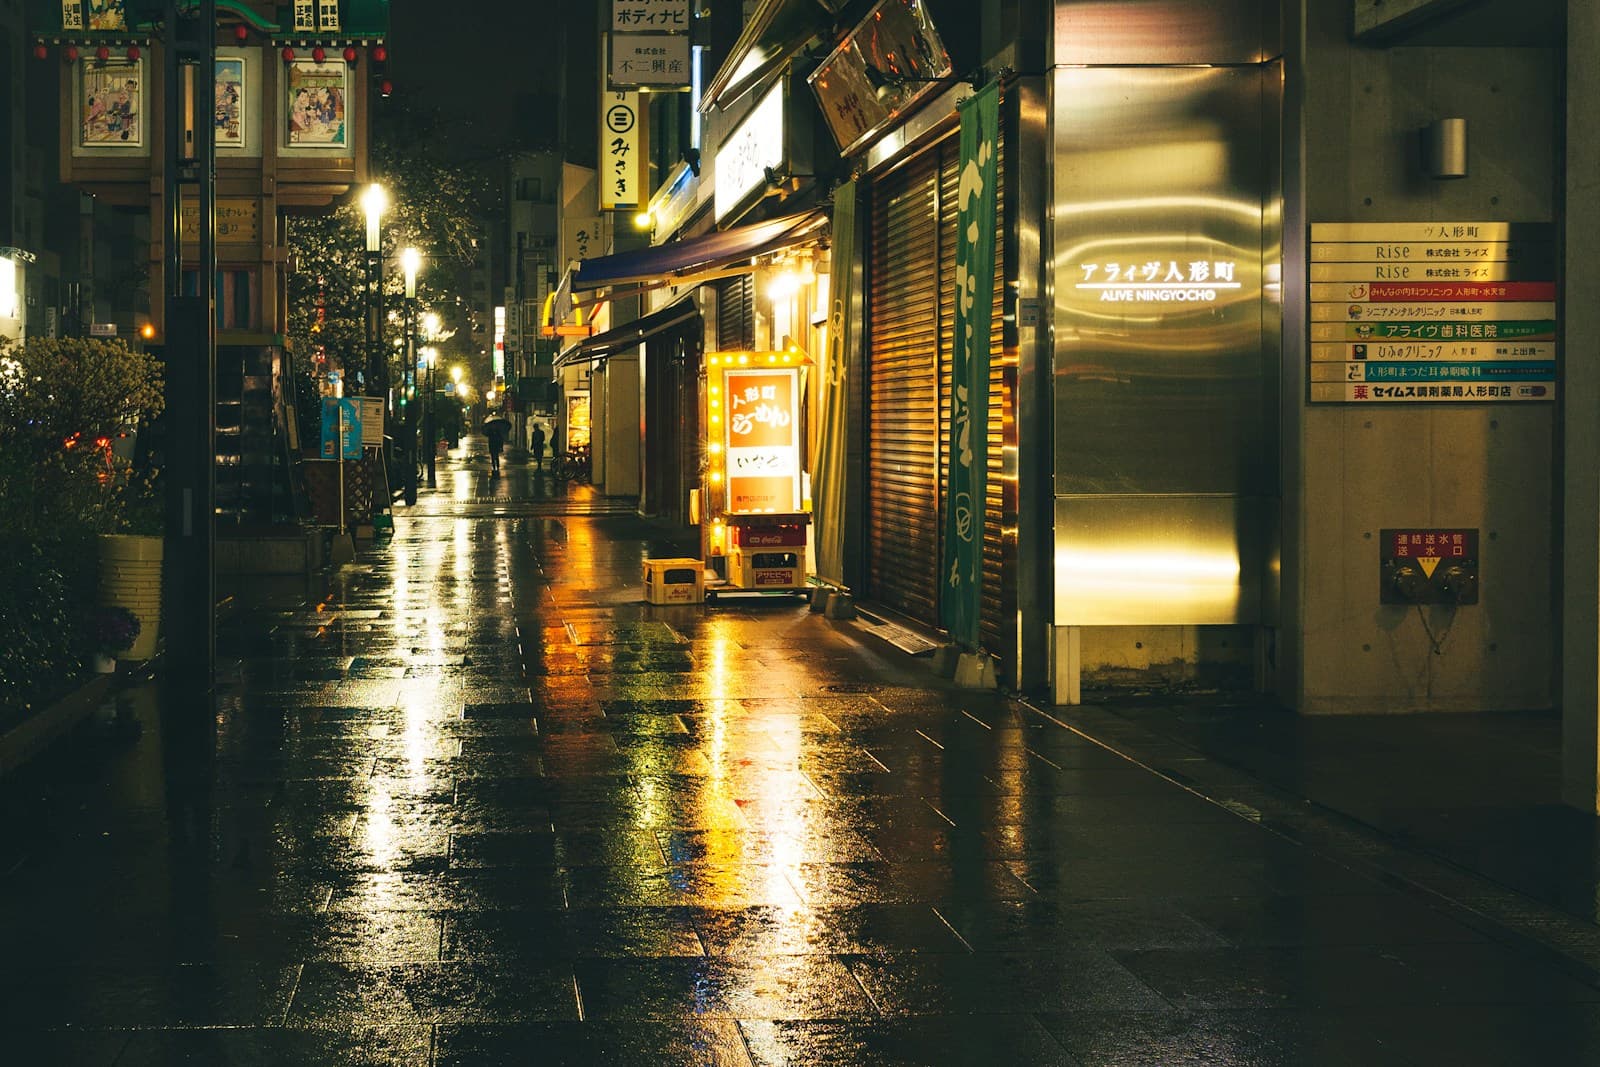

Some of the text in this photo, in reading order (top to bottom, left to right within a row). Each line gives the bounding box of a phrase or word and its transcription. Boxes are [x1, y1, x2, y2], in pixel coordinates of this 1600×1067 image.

[617, 9, 685, 24] ボディナビ
[634, 47, 667, 55] 株式会社
[619, 59, 682, 73] 不二興産
[610, 137, 630, 197] みさき
[1376, 245, 1410, 259] Rise
[1426, 248, 1460, 257] 株式会社
[1463, 248, 1489, 257] ライズ
[1376, 265, 1410, 279] Rise
[1426, 268, 1460, 277] 株式会社
[1463, 268, 1489, 277] ライズ
[1101, 289, 1216, 301] ALIVE NINGYOCHO
[1365, 307, 1446, 317] シニアメンタルクリニック
[1386, 325, 1498, 338] アライヴ歯科医院
[732, 385, 777, 410] 人形町
[1373, 386, 1512, 398] セイムス調剤薬局人形町店
[732, 403, 790, 435] らーめん
[1398, 534, 1464, 545] 連結送水管
[1398, 546, 1463, 556] 送水口
